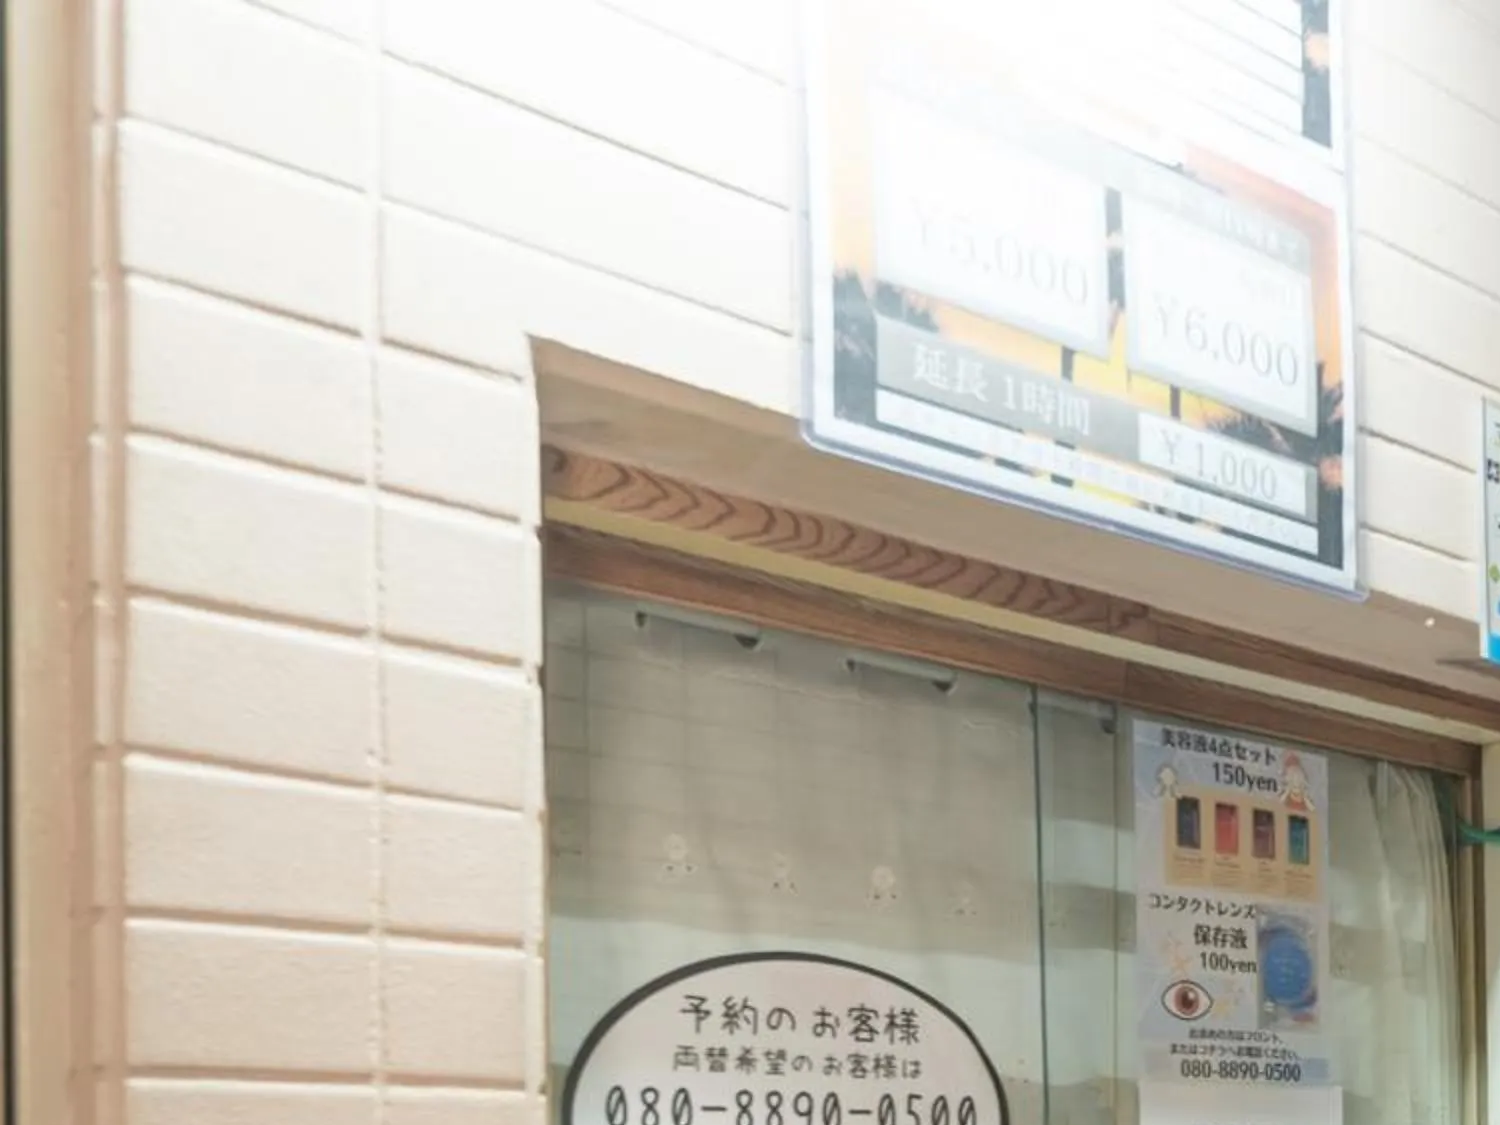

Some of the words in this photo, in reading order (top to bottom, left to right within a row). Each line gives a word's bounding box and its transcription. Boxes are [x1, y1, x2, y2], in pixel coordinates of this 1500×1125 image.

[913, 343, 989, 402] 延長
[1212, 761, 1279, 793] 150yen
[1200, 951, 1257, 974] 100yen
[680, 994, 922, 1046] 予約のお客様
[672, 1045, 923, 1080] 両替希望のお客様は
[1180, 1058, 1302, 1082] 080-8890-0500
